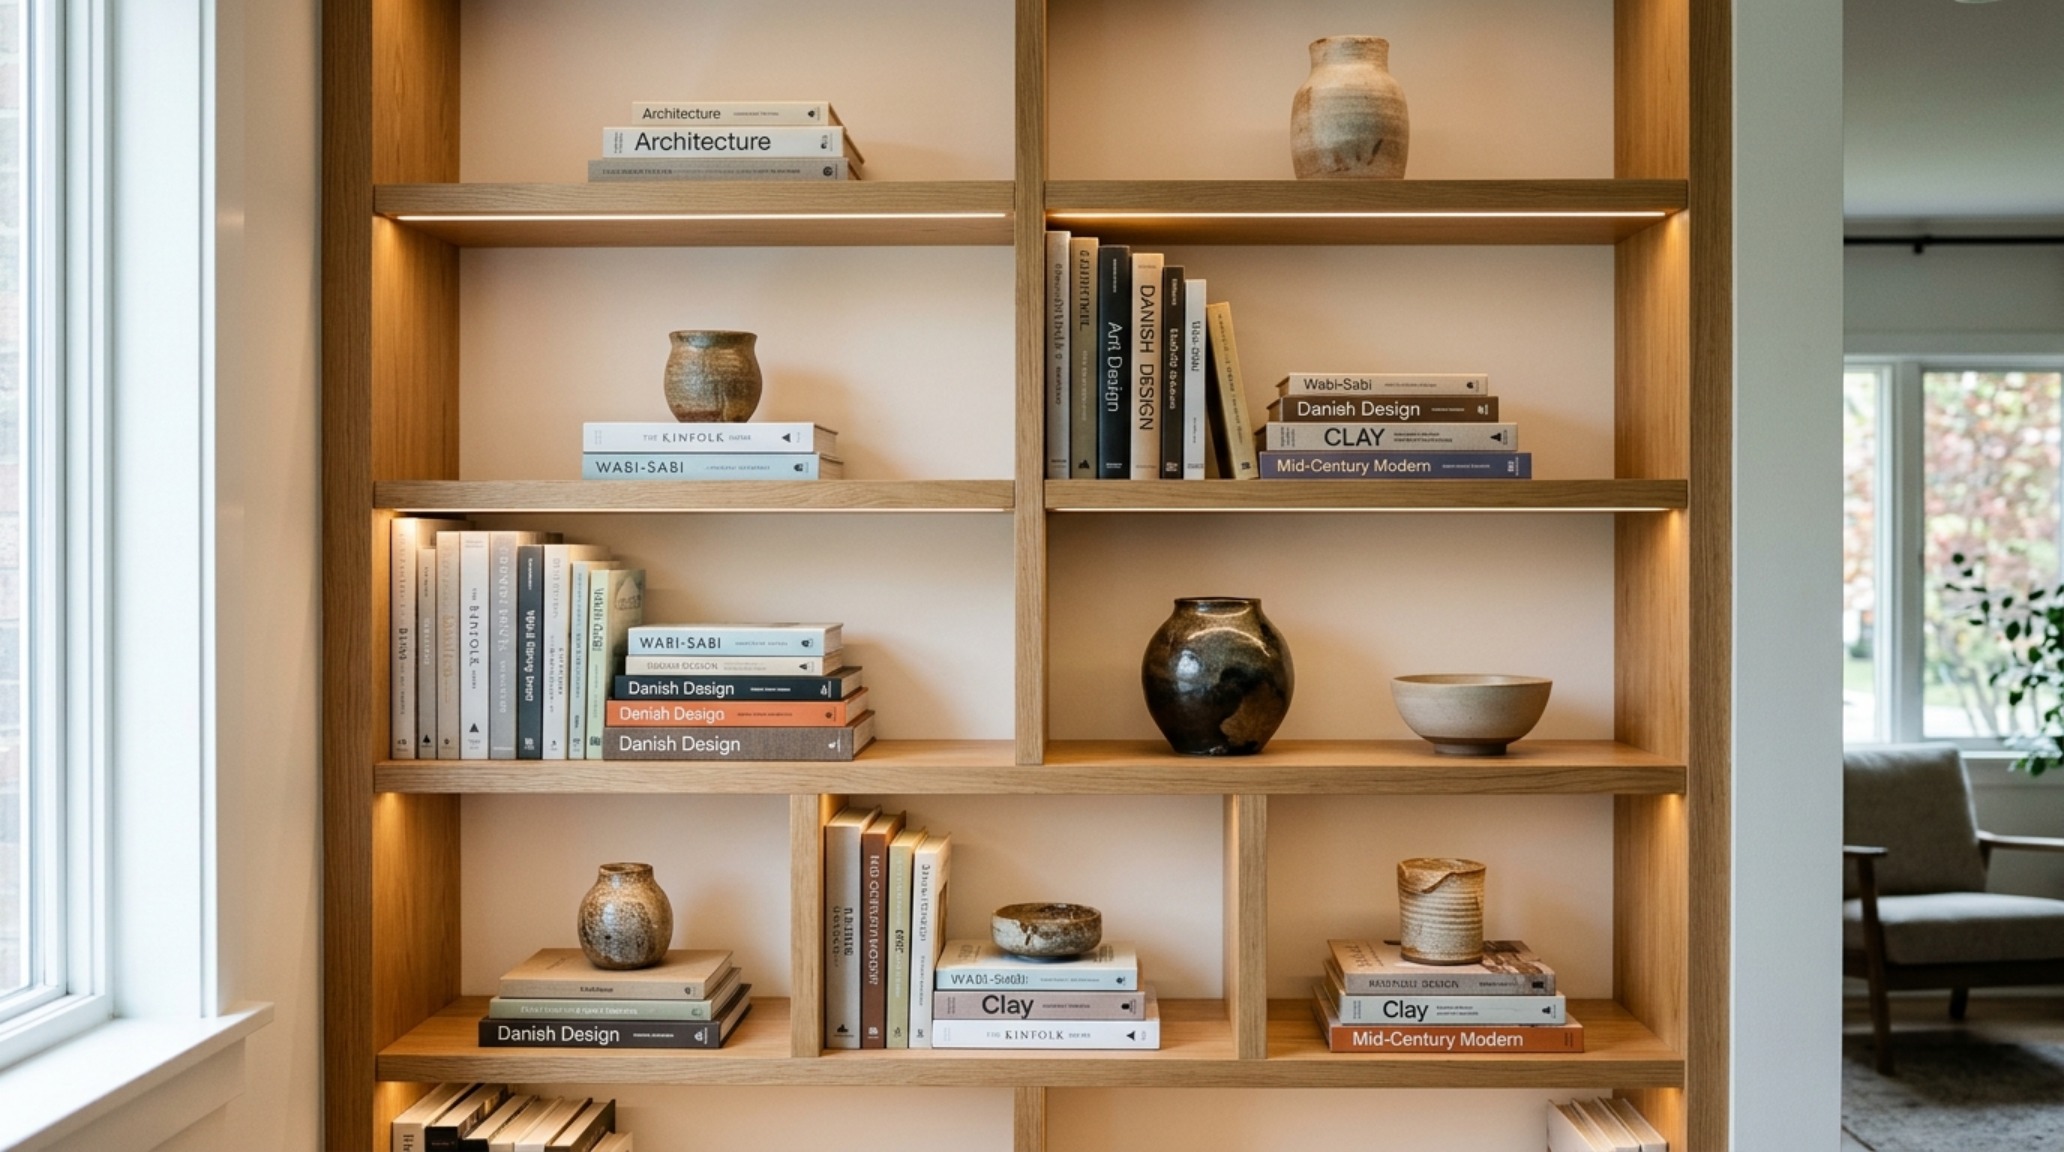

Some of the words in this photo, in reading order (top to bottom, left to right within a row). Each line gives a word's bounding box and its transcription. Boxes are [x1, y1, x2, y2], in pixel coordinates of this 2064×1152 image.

[642, 108, 721, 120] Architecture
[634, 132, 772, 151] Architecture
[1139, 285, 1156, 353] DANISH
[1303, 378, 1372, 391] Wabi-Sabi
[1361, 401, 1421, 421] Design
[662, 432, 725, 444] KINFOLK
[1324, 427, 1386, 447] CLAY
[1276, 458, 1370, 477] Mid-Century
[628, 681, 679, 696] Danish
[683, 681, 735, 699] Design
[619, 735, 677, 752] Danish
[681, 735, 741, 756] Design
[981, 994, 1035, 1020] Clay
[1382, 999, 1430, 1023] Clay
[497, 1025, 556, 1042] Danish
[560, 1025, 621, 1046] Design
[1352, 1031, 1456, 1051] Mid-Century
